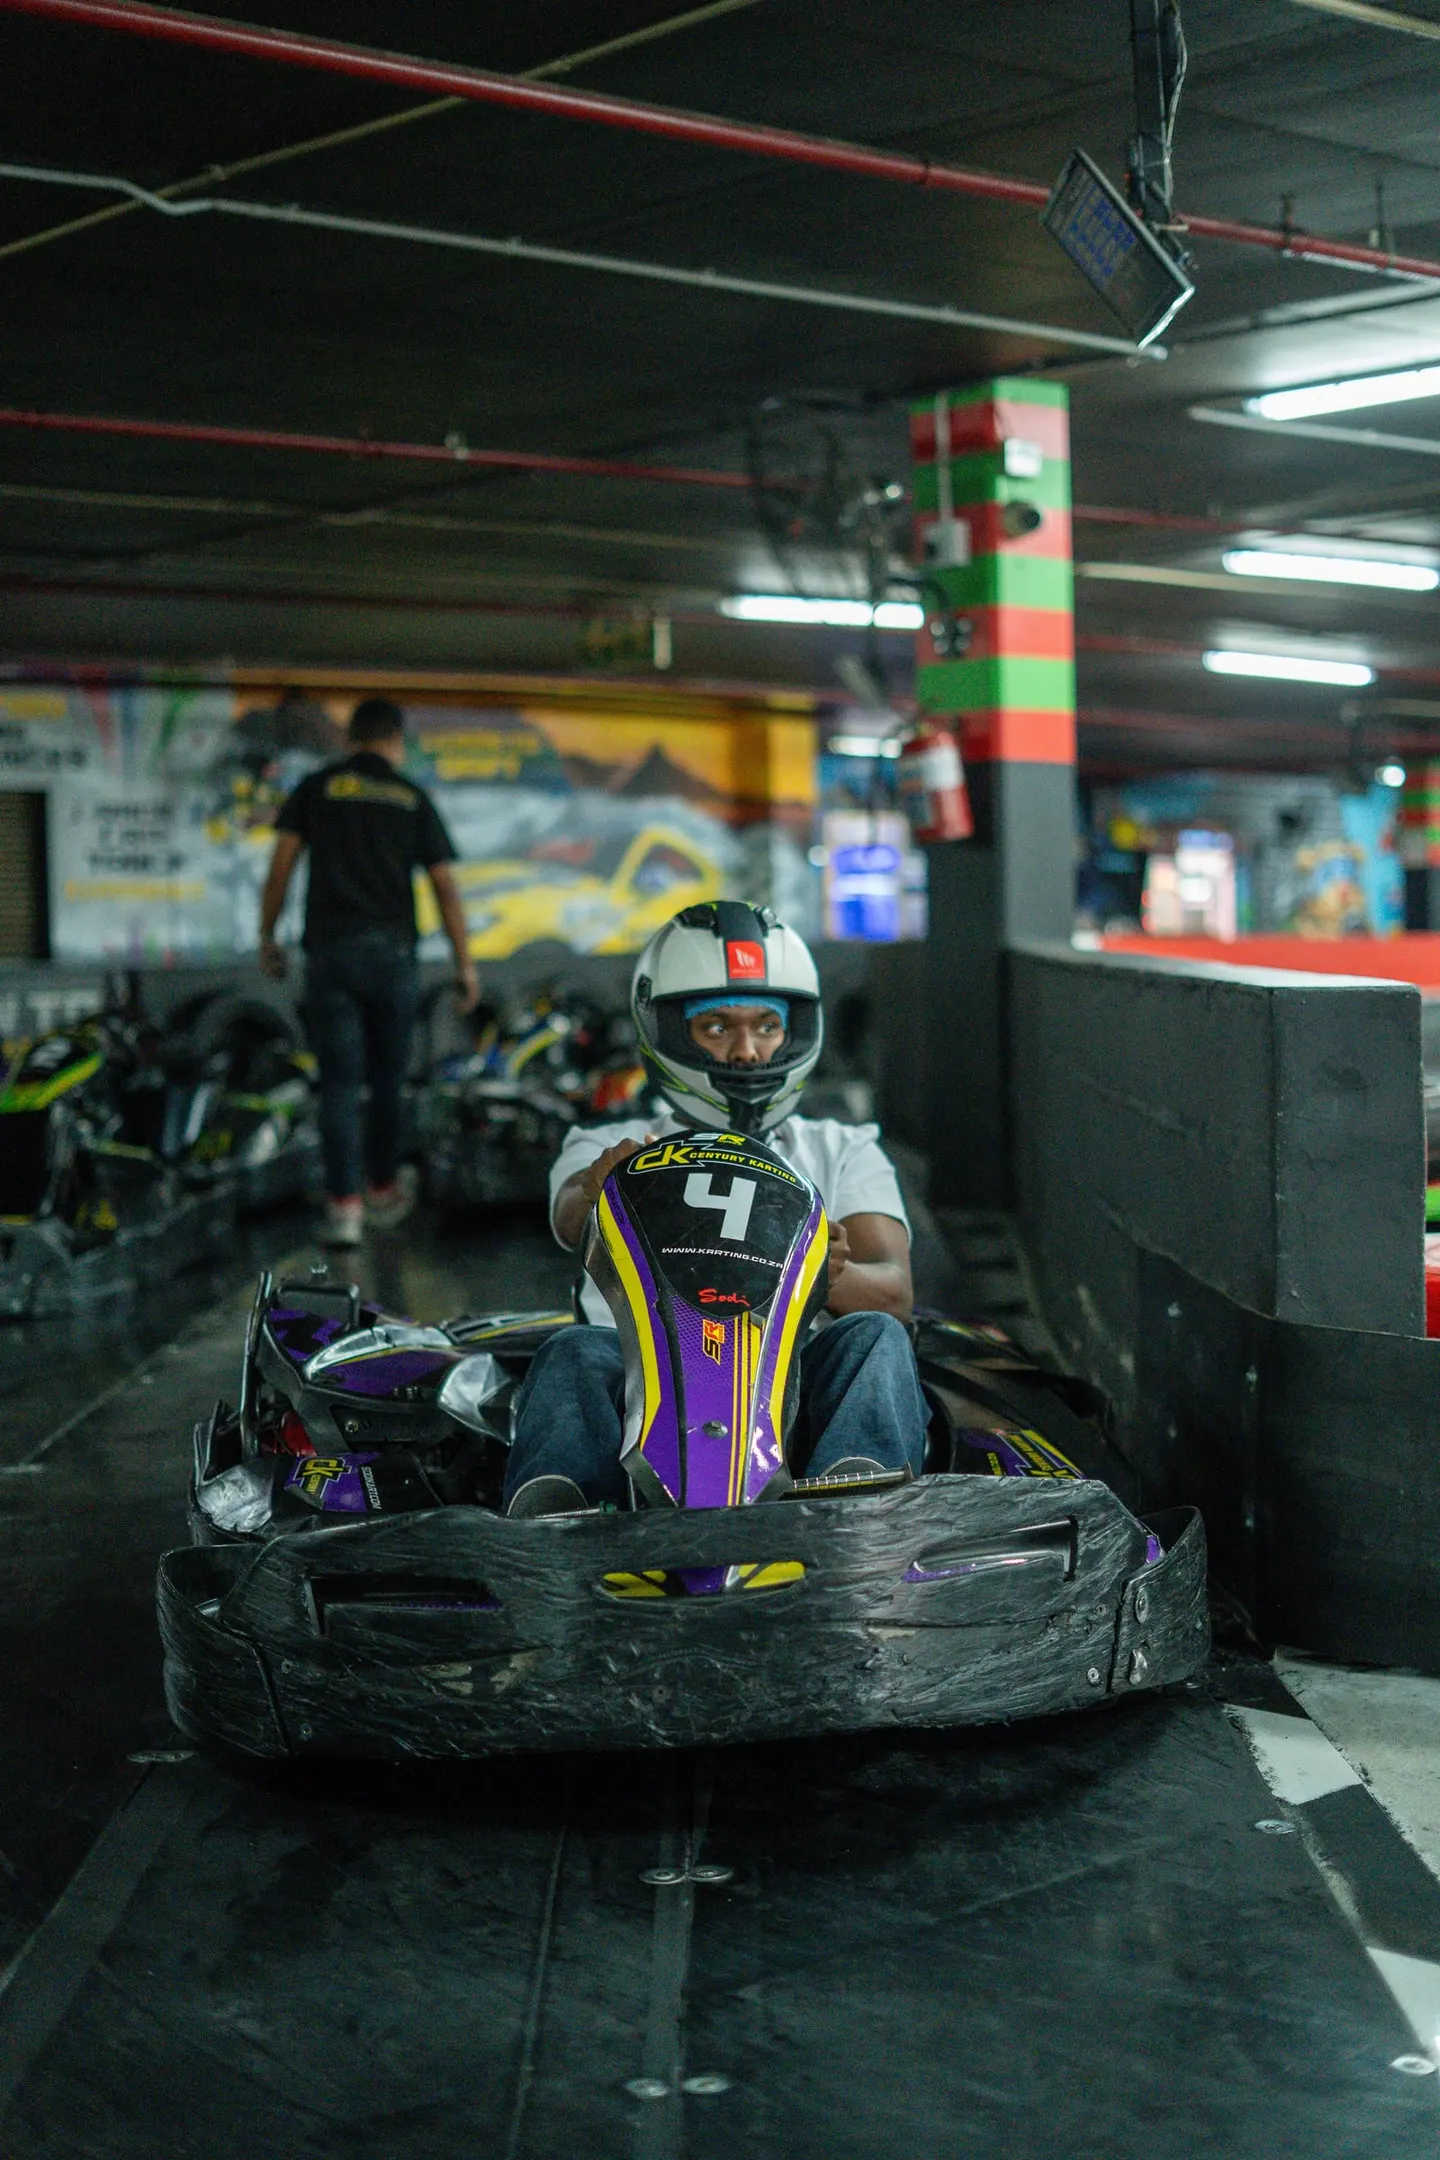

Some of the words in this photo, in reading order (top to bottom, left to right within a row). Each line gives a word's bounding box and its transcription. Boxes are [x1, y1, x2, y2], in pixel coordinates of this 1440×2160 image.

[689, 1152, 746, 1163] CENTURY
[749, 1159, 797, 1183] KARTING
[683, 1172, 757, 1241] 4
[661, 1247, 784, 1269] WWW.KARTING.CO.ZA
[698, 1288, 751, 1307] Sodi
